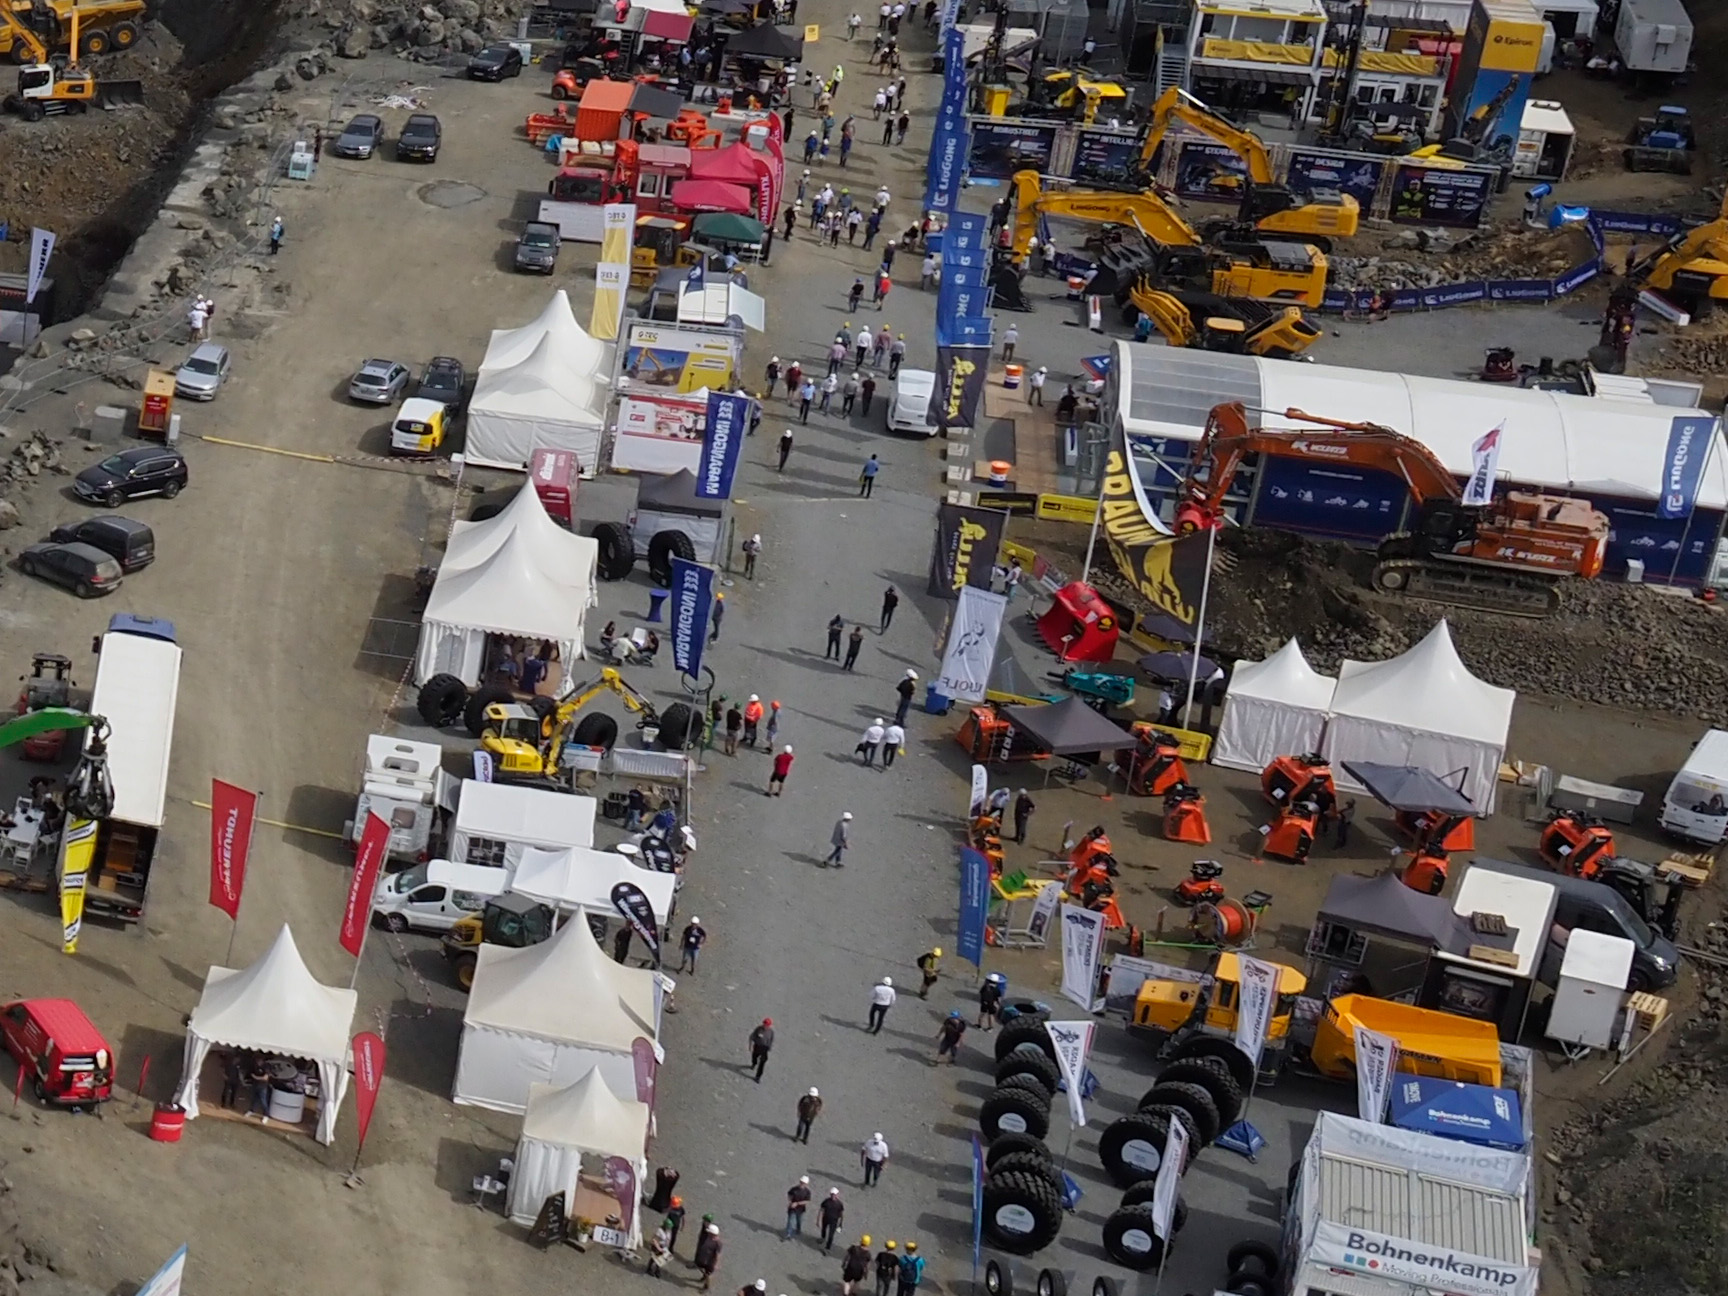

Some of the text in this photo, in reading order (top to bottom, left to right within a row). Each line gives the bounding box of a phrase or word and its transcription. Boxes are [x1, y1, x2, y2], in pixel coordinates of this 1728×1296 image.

[1504, 36, 1534, 47] Epiroc
[1313, 156, 1345, 168] DESIGN
[1346, 1232, 1516, 1285] Bohnenkamp
[1382, 1261, 1426, 1282] Moving
